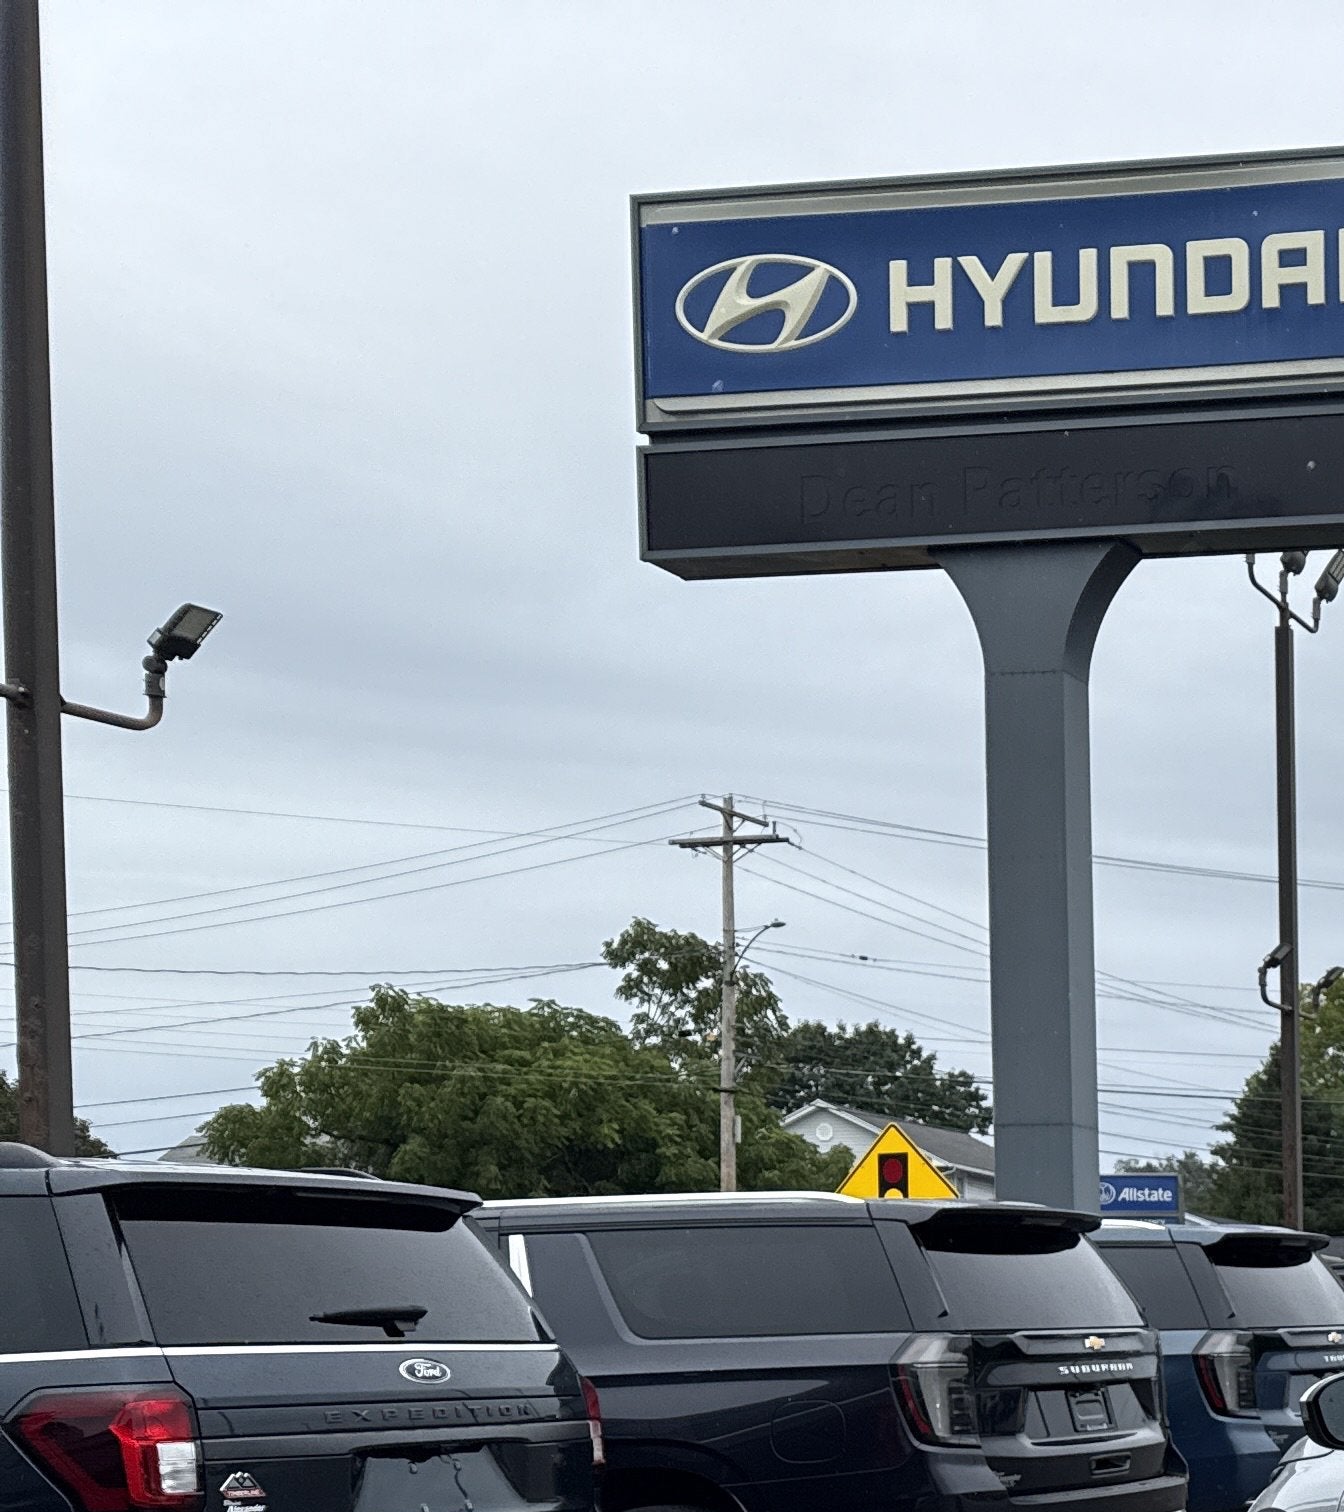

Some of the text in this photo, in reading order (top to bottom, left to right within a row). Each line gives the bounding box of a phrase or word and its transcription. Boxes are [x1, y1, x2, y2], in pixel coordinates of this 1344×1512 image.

[800, 464, 1236, 524] Dean Patterson
[1118, 1187, 1173, 1201] Allstate
[414, 1362, 442, 1378] Ford
[1058, 1362, 1134, 1375] SUBURBAN
[324, 1402, 532, 1424] EXPEDITION
